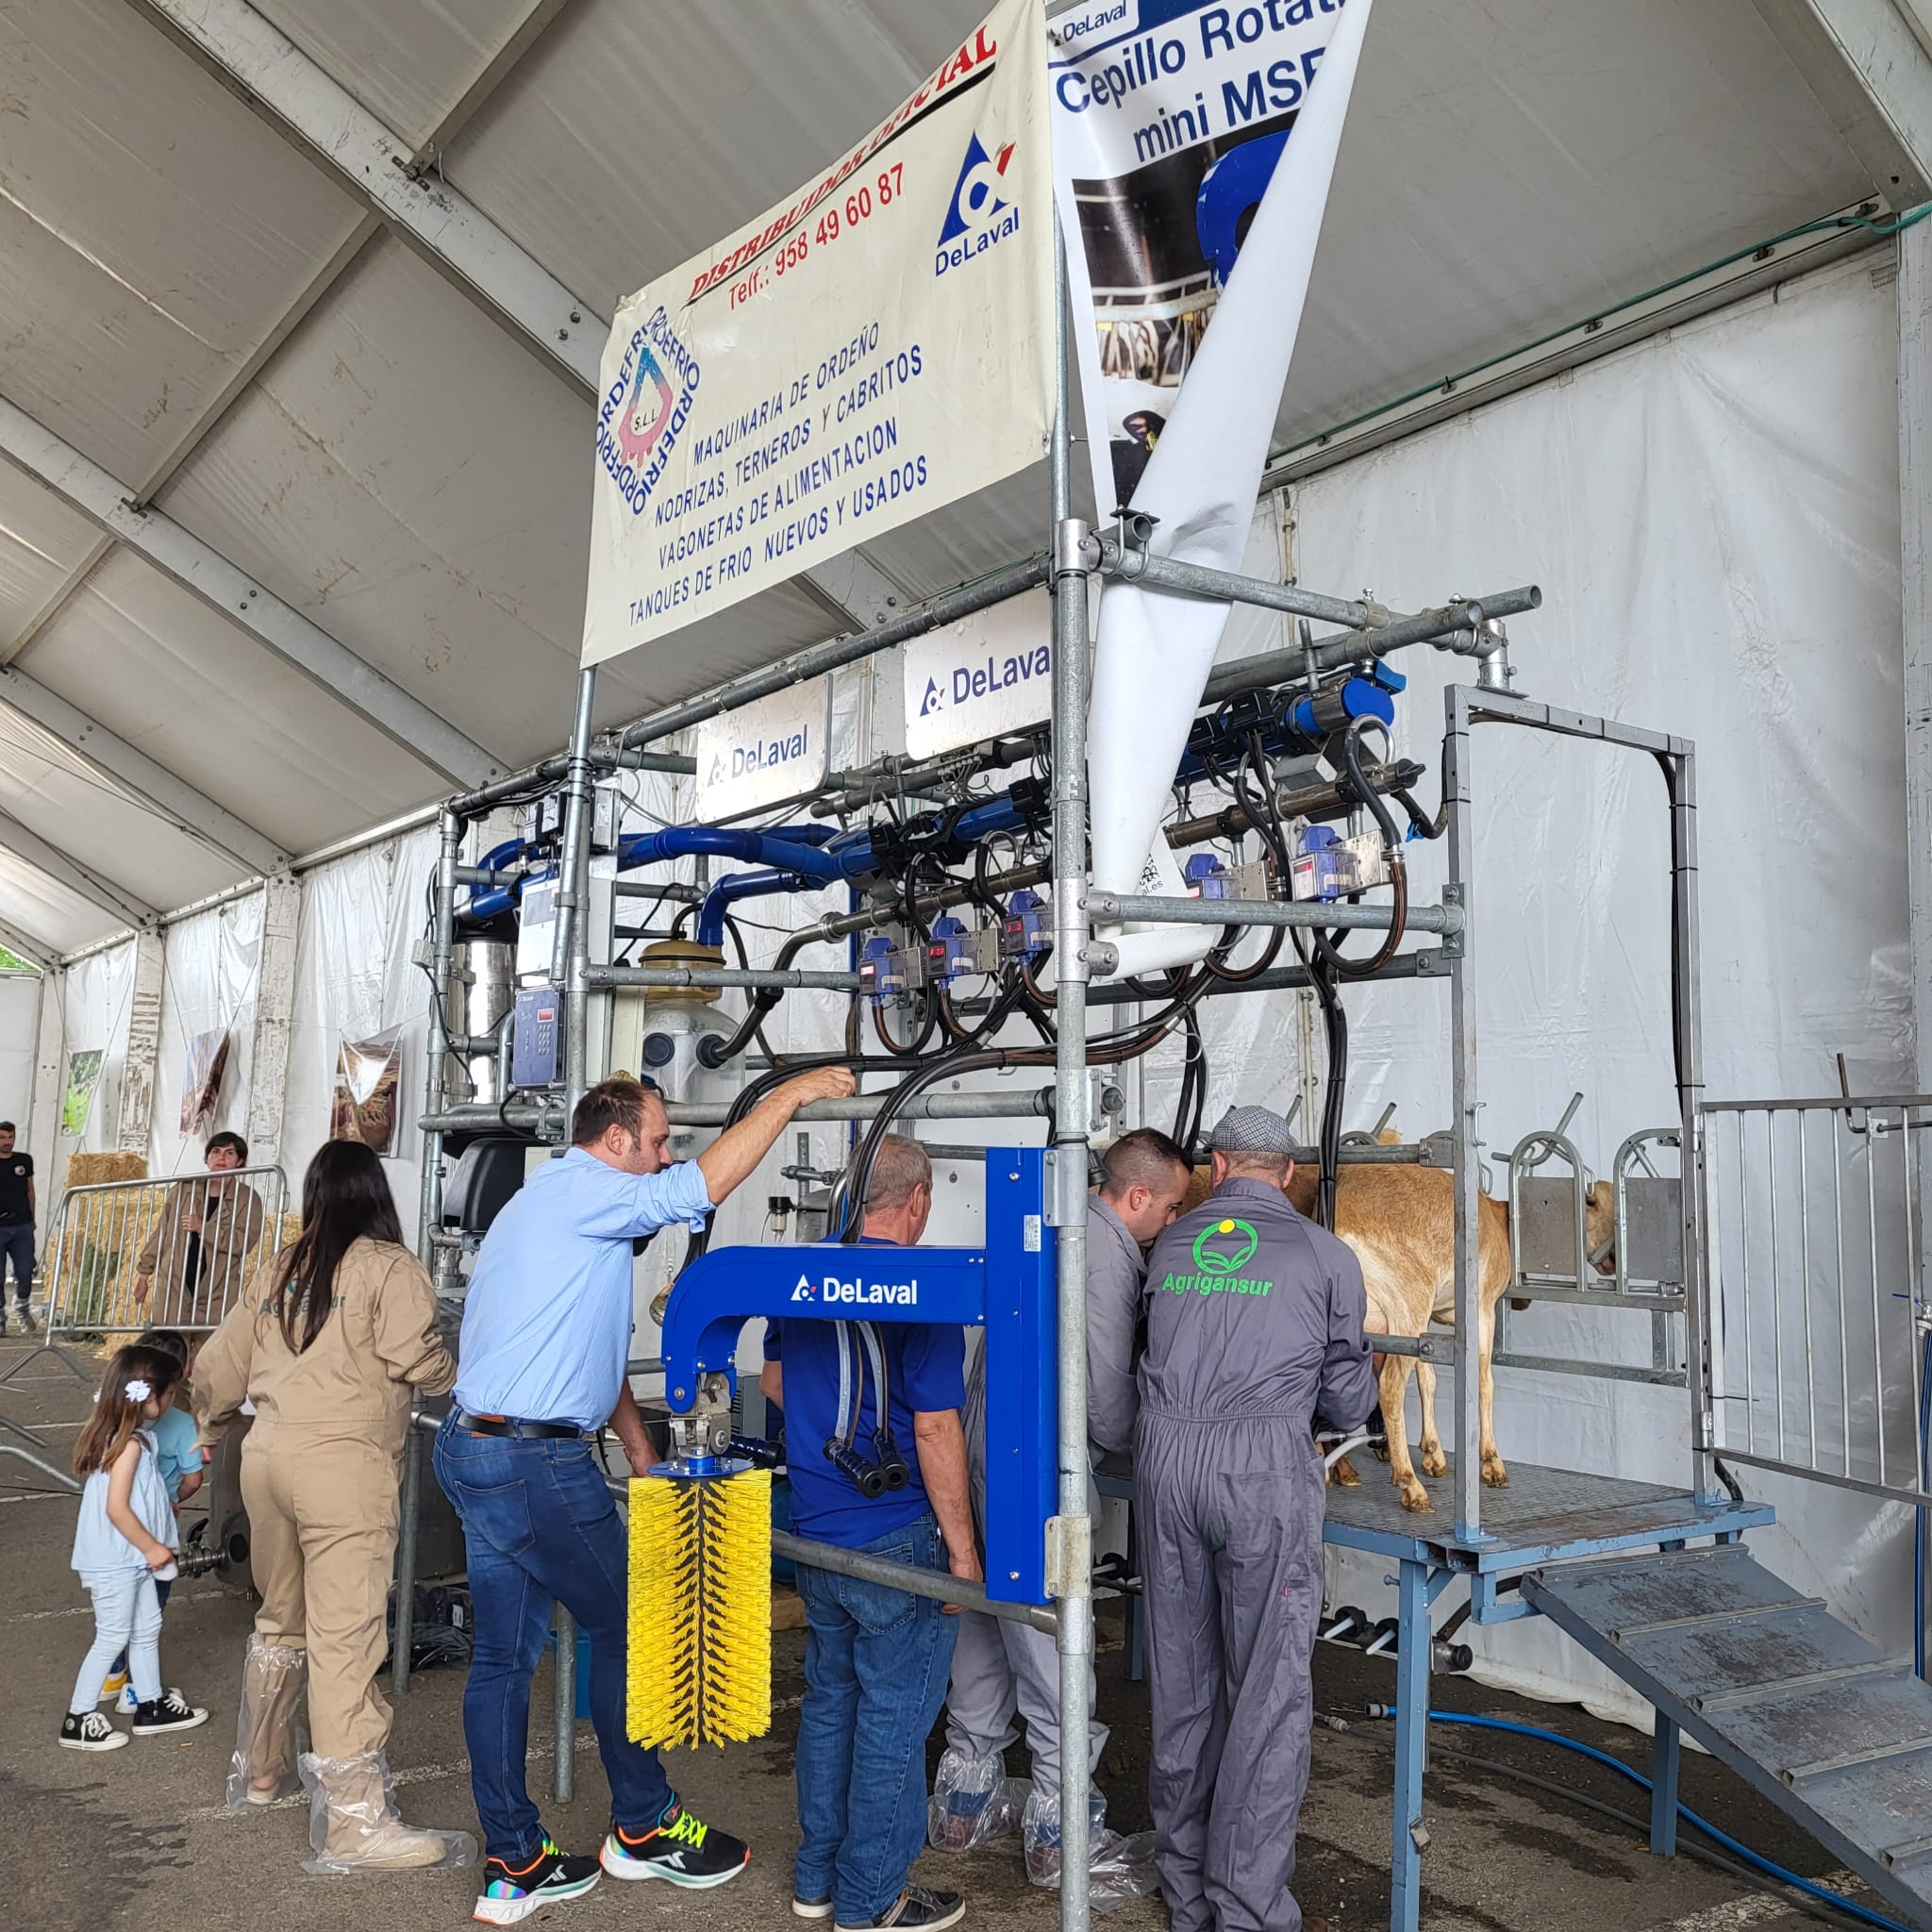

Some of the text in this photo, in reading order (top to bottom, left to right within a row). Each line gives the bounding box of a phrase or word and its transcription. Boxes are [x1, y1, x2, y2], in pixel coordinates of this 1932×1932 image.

[1056, 0, 1344, 113] Cepillo Rota
[1063, 0, 1126, 42] DeLaval
[687, 24, 997, 303] DISTRIBUIDOR OFICIAL
[1133, 92, 1209, 162] mini
[775, 231, 808, 275] 958
[815, 209, 840, 246] 49
[846, 187, 872, 226] 60
[878, 162, 904, 206] 87
[936, 207, 1020, 276] DeLaval
[655, 344, 922, 528] NODRIZAS, TERNEROS Y CABRITOS
[693, 322, 879, 467] MAQUINARIA DE ORDEÑO
[658, 416, 897, 570] VAGONETAS DE ALIMENTACION
[629, 455, 927, 626] TANQUES DE FRIO NUEVOS Y USADOS
[953, 645, 1050, 705] DeLava
[732, 724, 808, 779] DeLaval
[823, 1277, 918, 1305] DeLaval
[1162, 1272, 1273, 1297] Agrigansur
